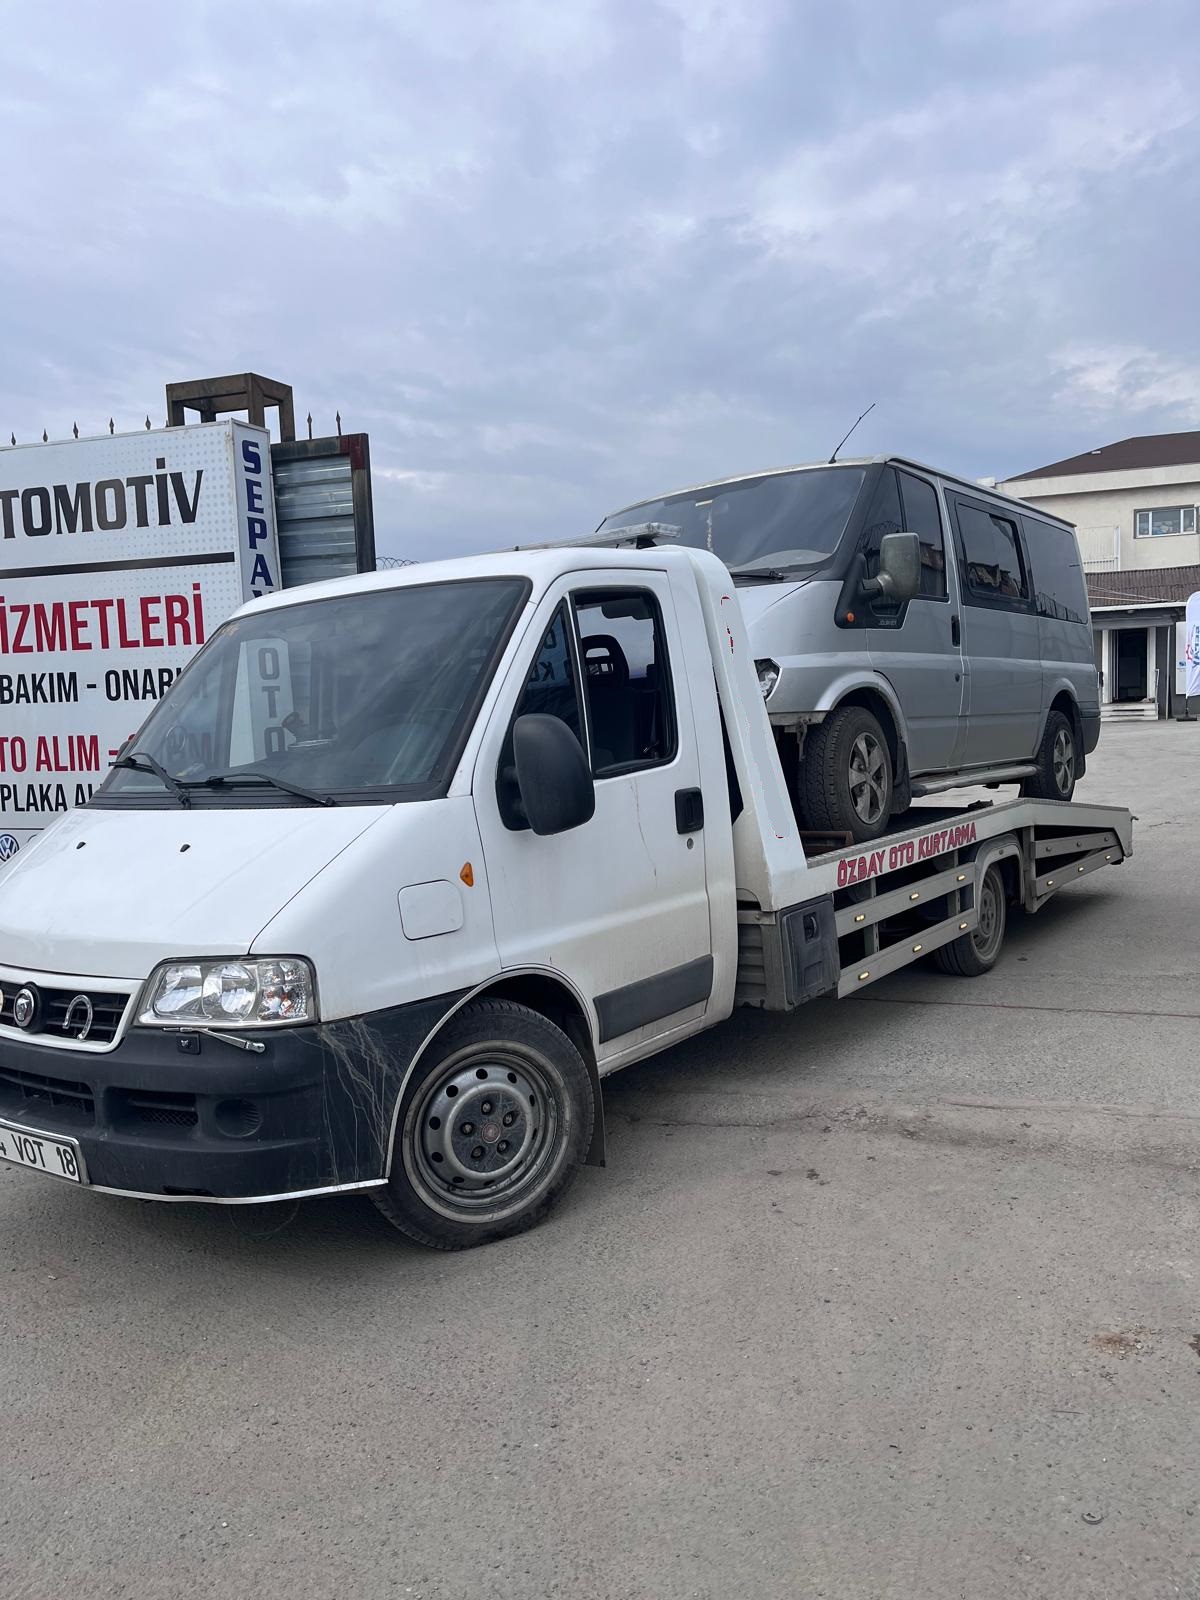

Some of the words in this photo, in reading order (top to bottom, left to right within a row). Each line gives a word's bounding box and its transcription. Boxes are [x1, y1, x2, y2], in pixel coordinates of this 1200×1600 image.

[241, 439, 274, 599] SEPA
[0, 671, 79, 705] BAKIM
[35, 734, 100, 772] ALIM
[0, 783, 68, 812] PLAKA
[837, 850, 885, 887] ÖZBAY
[889, 841, 914, 869] OTO
[917, 822, 977, 860] KURTARMA
[11, 1134, 45, 1167] VOT
[56, 1147, 76, 1176] 18
